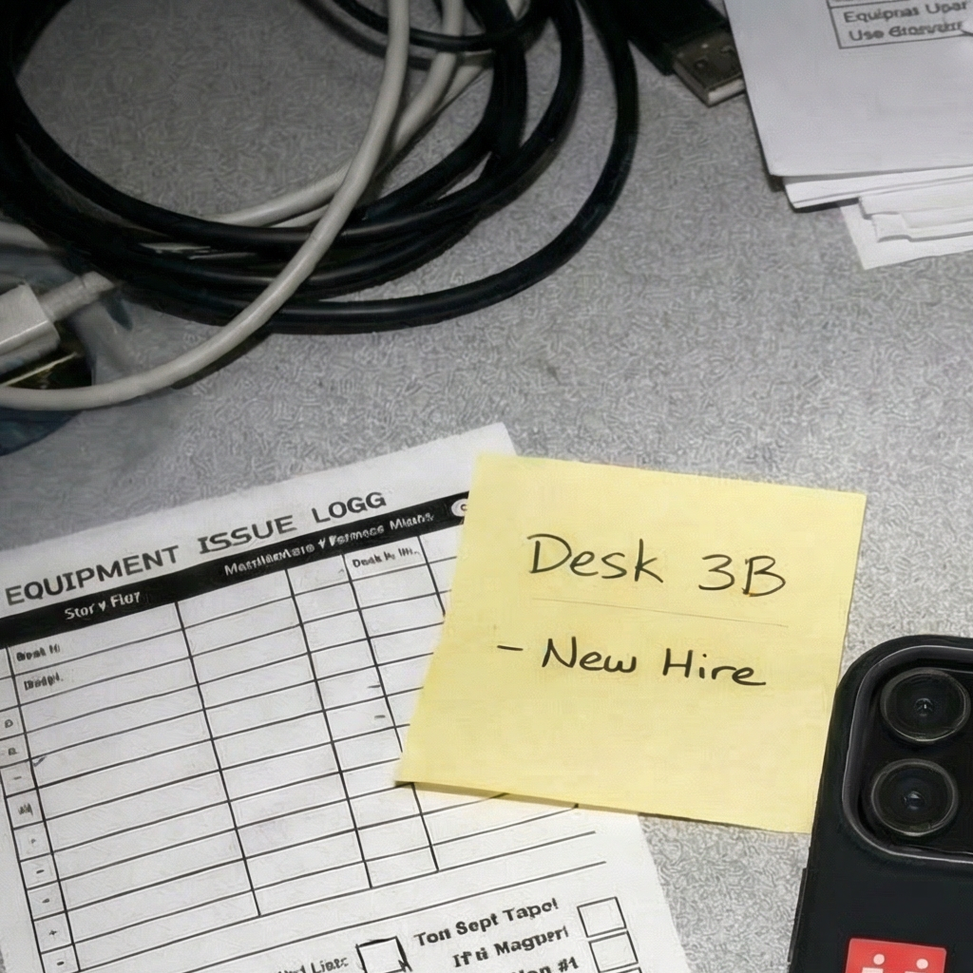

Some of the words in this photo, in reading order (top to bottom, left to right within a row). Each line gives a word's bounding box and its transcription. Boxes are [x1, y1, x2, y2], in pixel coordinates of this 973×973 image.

[5, 545, 181, 606] EQUIPMENT
[199, 514, 296, 555] ISSUE
[311, 491, 387, 523] LOGG
[527, 533, 663, 583] Desk
[698, 554, 786, 597] 3B
[541, 636, 637, 673] New
[662, 648, 766, 686] Hire
[557, 956, 579, 973] #1
